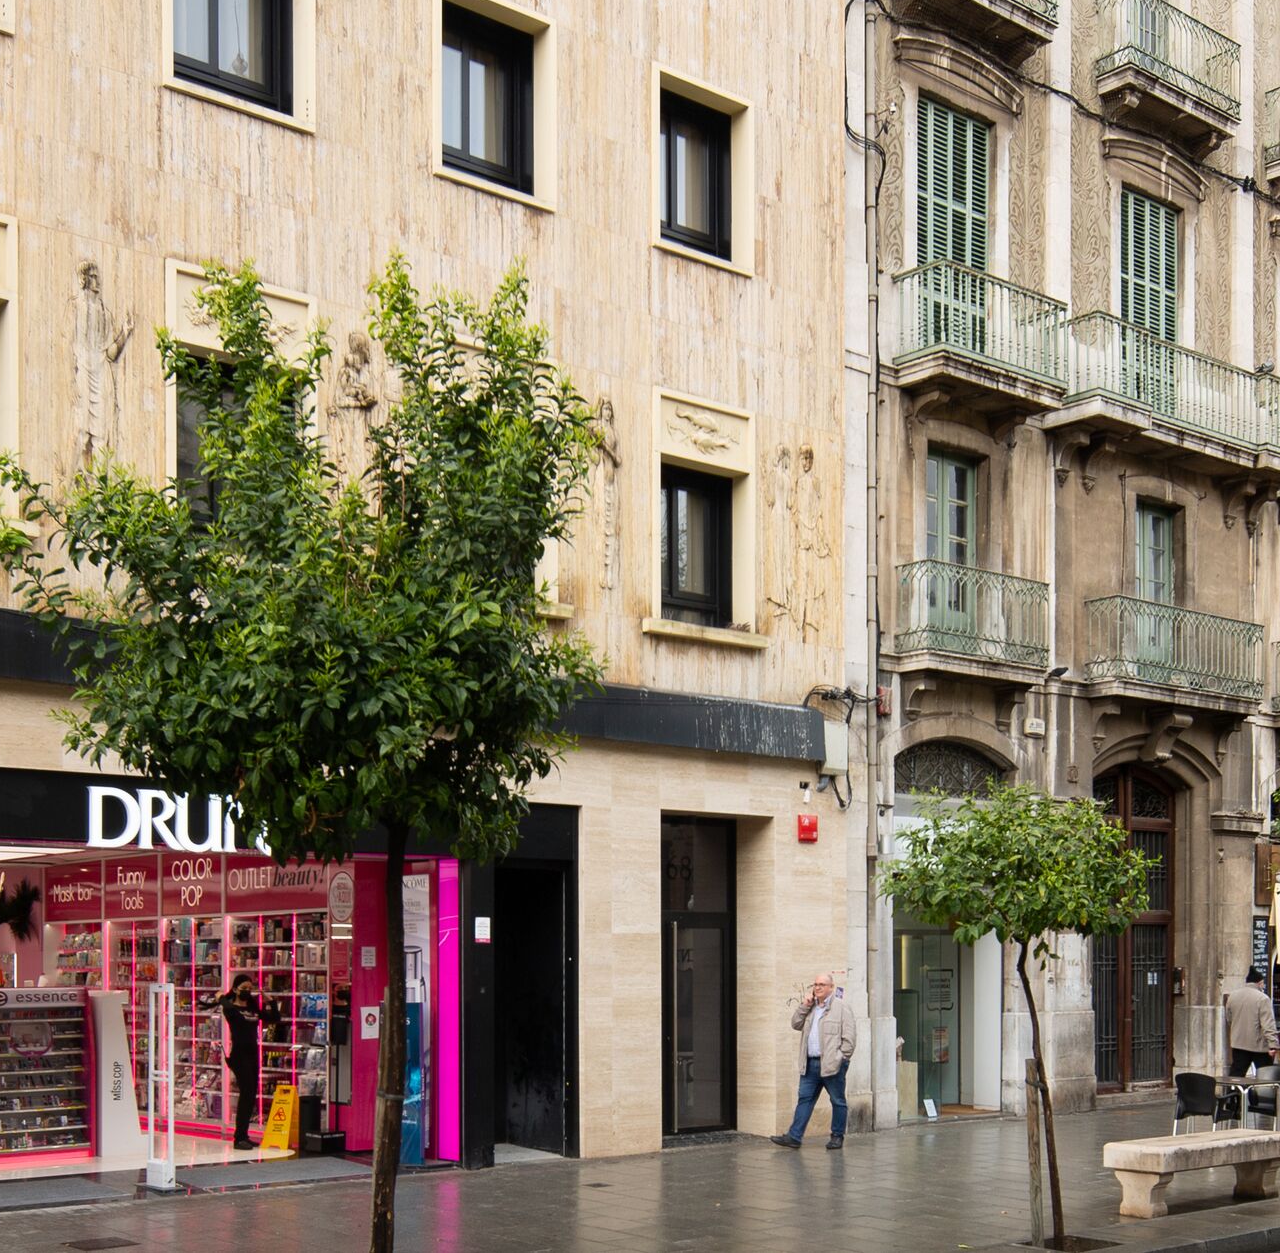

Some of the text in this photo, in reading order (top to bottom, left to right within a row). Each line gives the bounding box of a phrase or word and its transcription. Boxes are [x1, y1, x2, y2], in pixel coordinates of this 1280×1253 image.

[117, 866, 146, 887] Funny
[171, 858, 213, 882] COLOR
[228, 863, 325, 891] OUTLET beauty!
[667, 856, 692, 880] 68
[53, 883, 94, 903] Mask bar
[120, 891, 144, 910] Tools
[180, 885, 203, 907] POP
[16, 992, 78, 1003] essence
